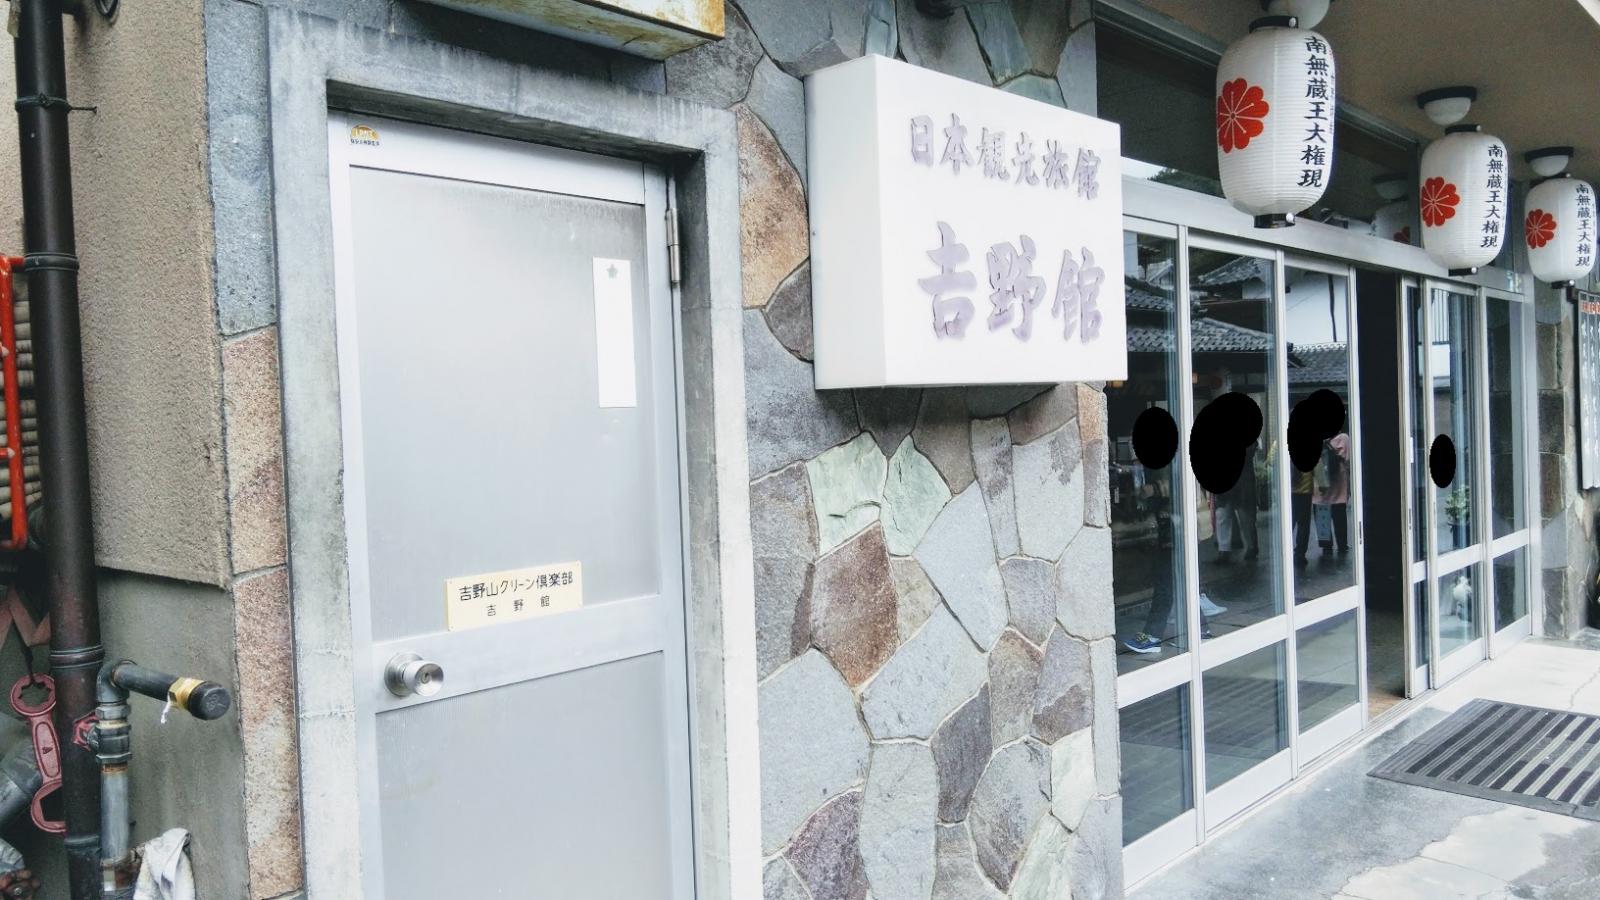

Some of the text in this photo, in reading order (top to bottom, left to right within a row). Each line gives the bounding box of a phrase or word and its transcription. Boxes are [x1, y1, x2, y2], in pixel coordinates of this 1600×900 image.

[1297, 35, 1329, 188] 南無蔵王大権現
[1480, 144, 1504, 248] 南無蔵王大権現
[458, 570, 574, 602] 吉野山クリーン倶楽部
